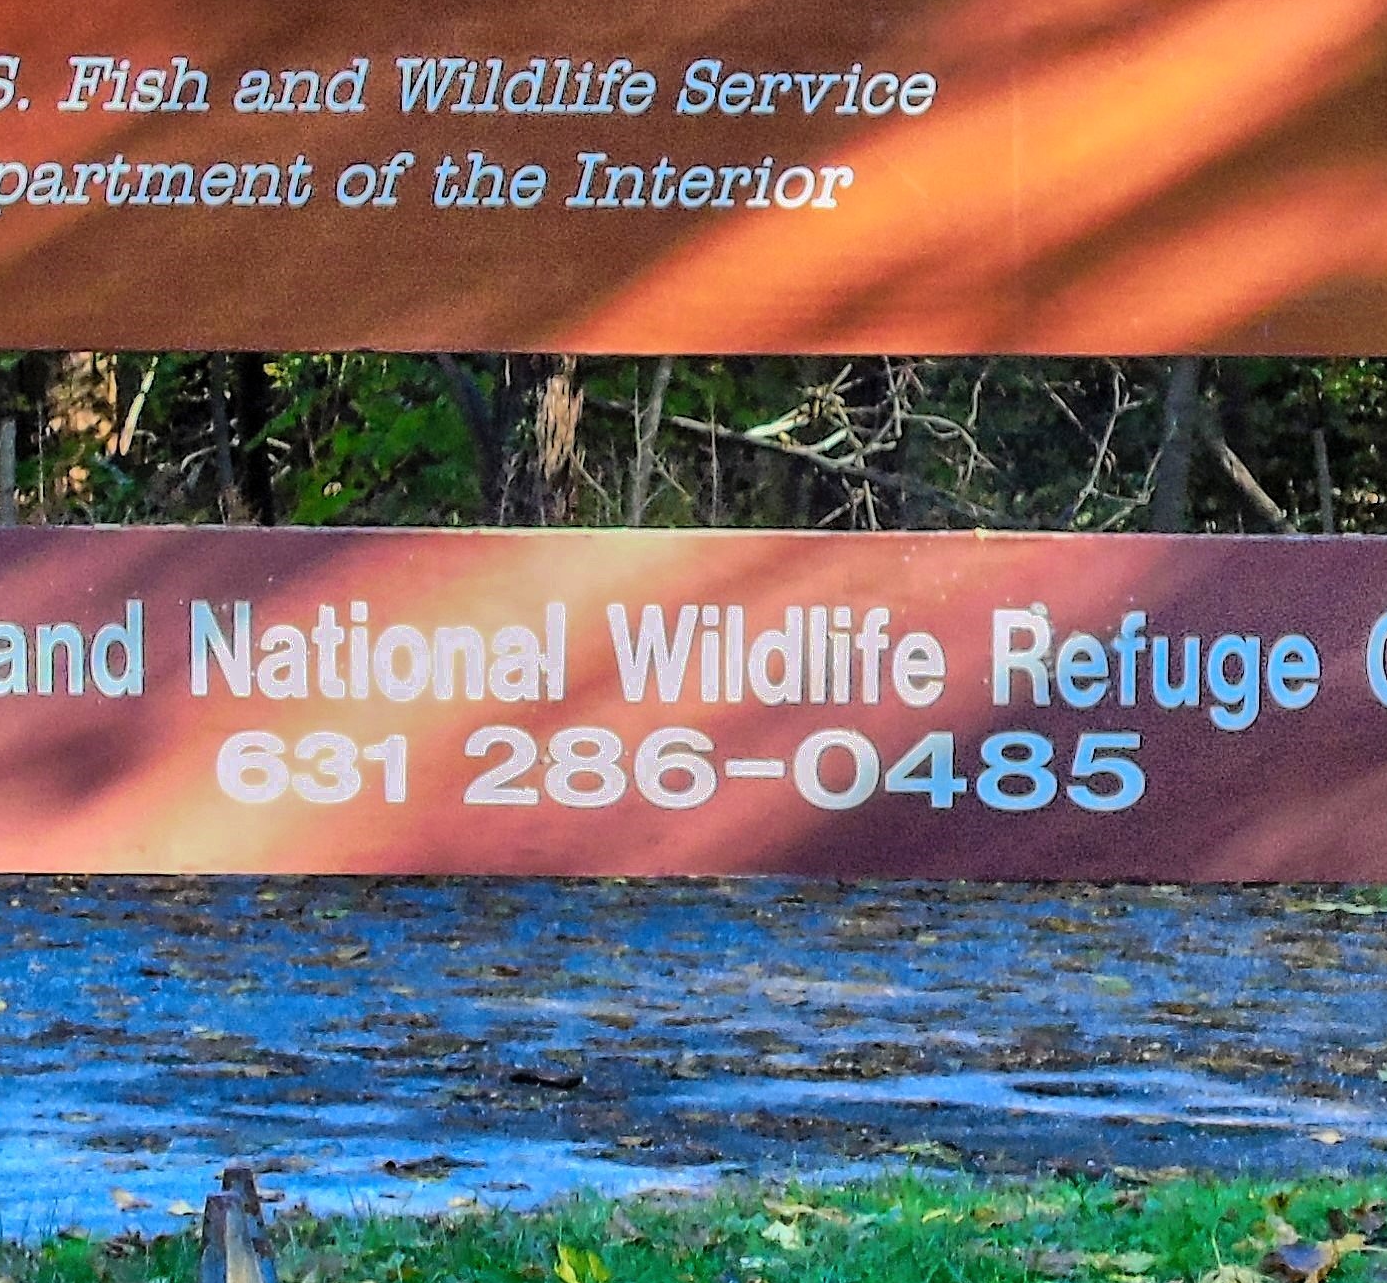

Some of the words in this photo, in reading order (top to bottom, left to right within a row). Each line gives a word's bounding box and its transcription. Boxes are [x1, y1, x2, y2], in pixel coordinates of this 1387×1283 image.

[57, 56, 211, 113] Fish
[233, 58, 370, 114] and
[395, 57, 657, 115] Wildlife
[675, 59, 937, 116] Service
[335, 151, 415, 208] of
[433, 151, 547, 208] the
[565, 151, 854, 209] Interior
[189, 600, 567, 702] National
[607, 603, 947, 706] Wildlife
[991, 604, 1322, 731] Refuge
[215, 730, 408, 804] 631
[462, 725, 1147, 811] 286-0485
